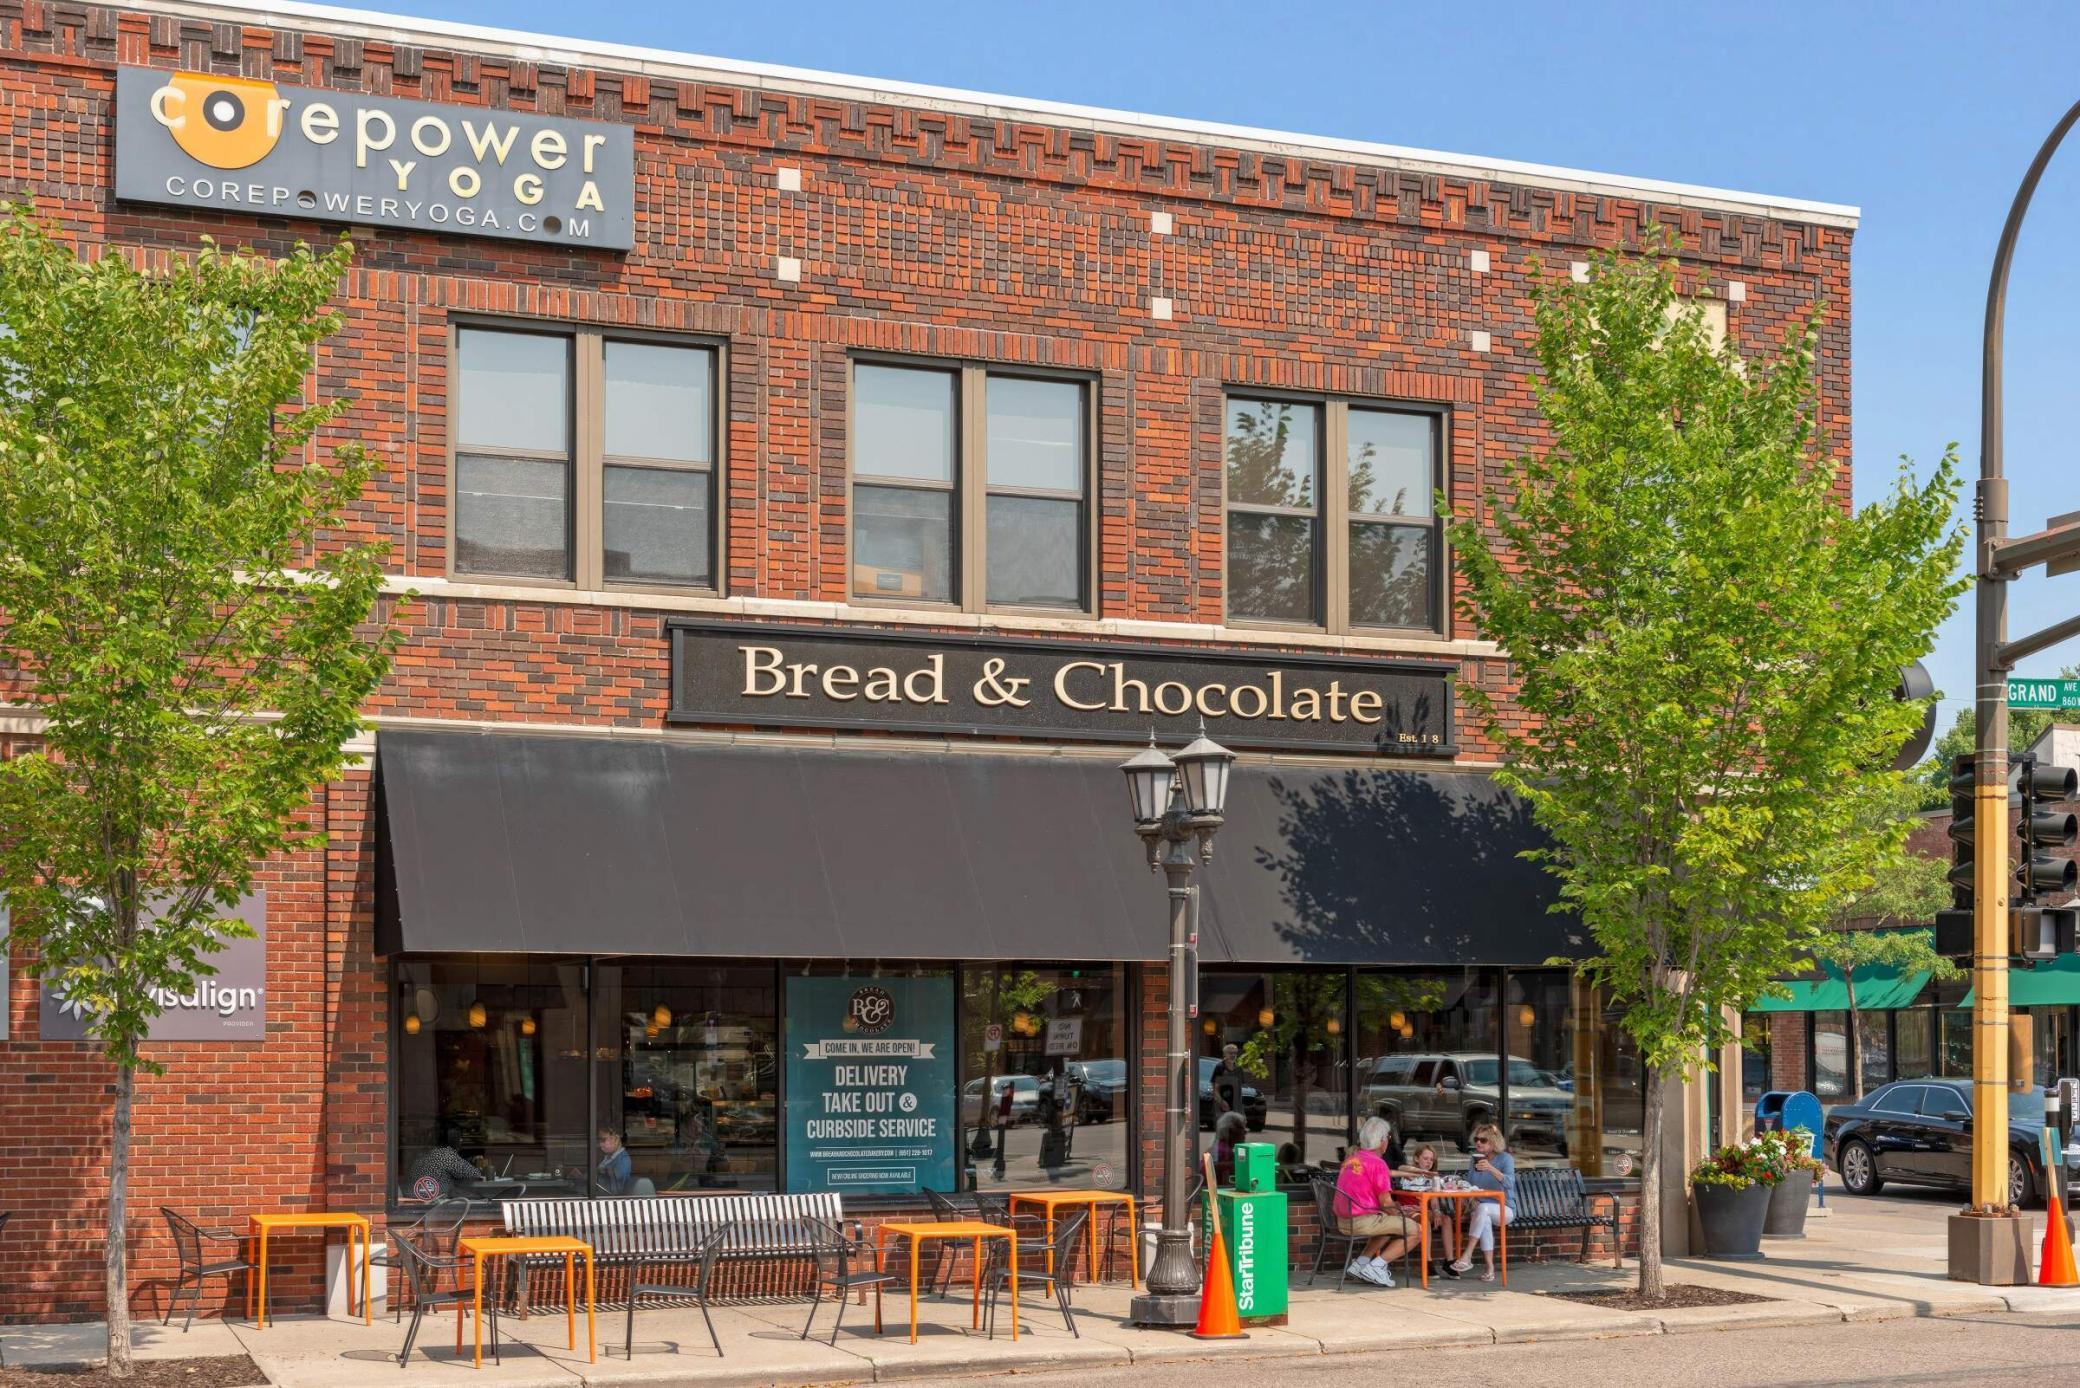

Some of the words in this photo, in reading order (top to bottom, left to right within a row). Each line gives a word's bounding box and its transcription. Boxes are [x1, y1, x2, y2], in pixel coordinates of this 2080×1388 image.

[389, 158, 605, 212] YOGA
[738, 645, 949, 704] Bread
[973, 656, 1032, 708] &
[1054, 661, 1384, 724] Chocolate
[2008, 683, 2057, 702] GRAND
[2063, 682, 2078, 692] AVE
[825, 1042, 847, 1054] COME
[861, 1042, 873, 1054] WE
[875, 1042, 891, 1054] ARE
[892, 1042, 915, 1054] OPEN!
[835, 1065, 908, 1086] DELIVERY
[822, 1092, 862, 1113] TAKE
[865, 1092, 895, 1113] OUT
[901, 1094, 915, 1110] &
[806, 1119, 875, 1139] CURBSIDE
[879, 1118, 936, 1138] SERVICE
[1239, 1202, 1254, 1311] StarTribune
